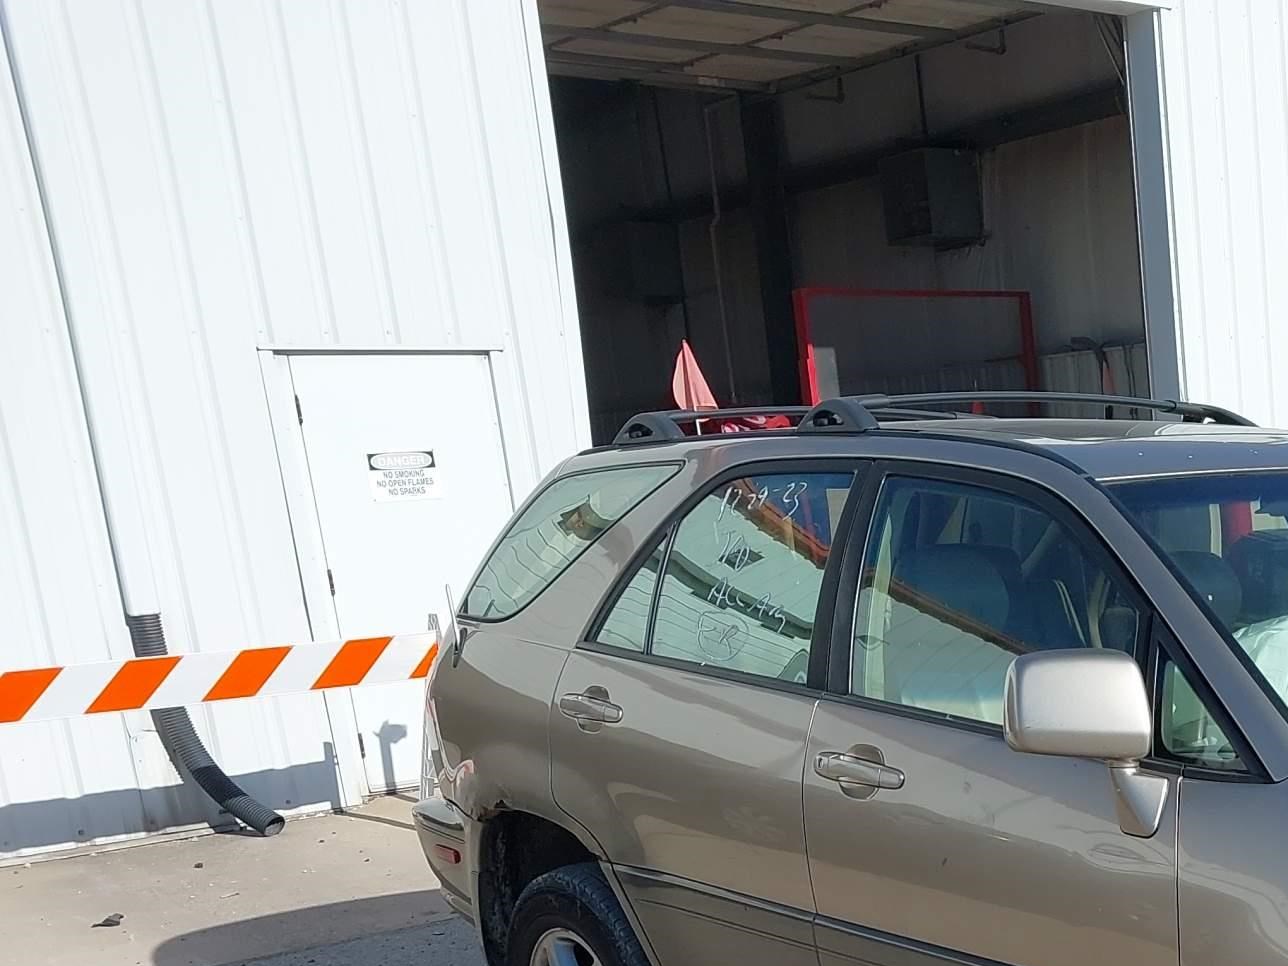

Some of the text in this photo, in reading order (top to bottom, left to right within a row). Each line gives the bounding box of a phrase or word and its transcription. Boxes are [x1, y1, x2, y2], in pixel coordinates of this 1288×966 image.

[377, 455, 425, 466] DANGER
[383, 469, 425, 479] NO SMOKING
[377, 477, 434, 488] NO OPEN FLAMES
[388, 486, 426, 496] NO SPARKS
